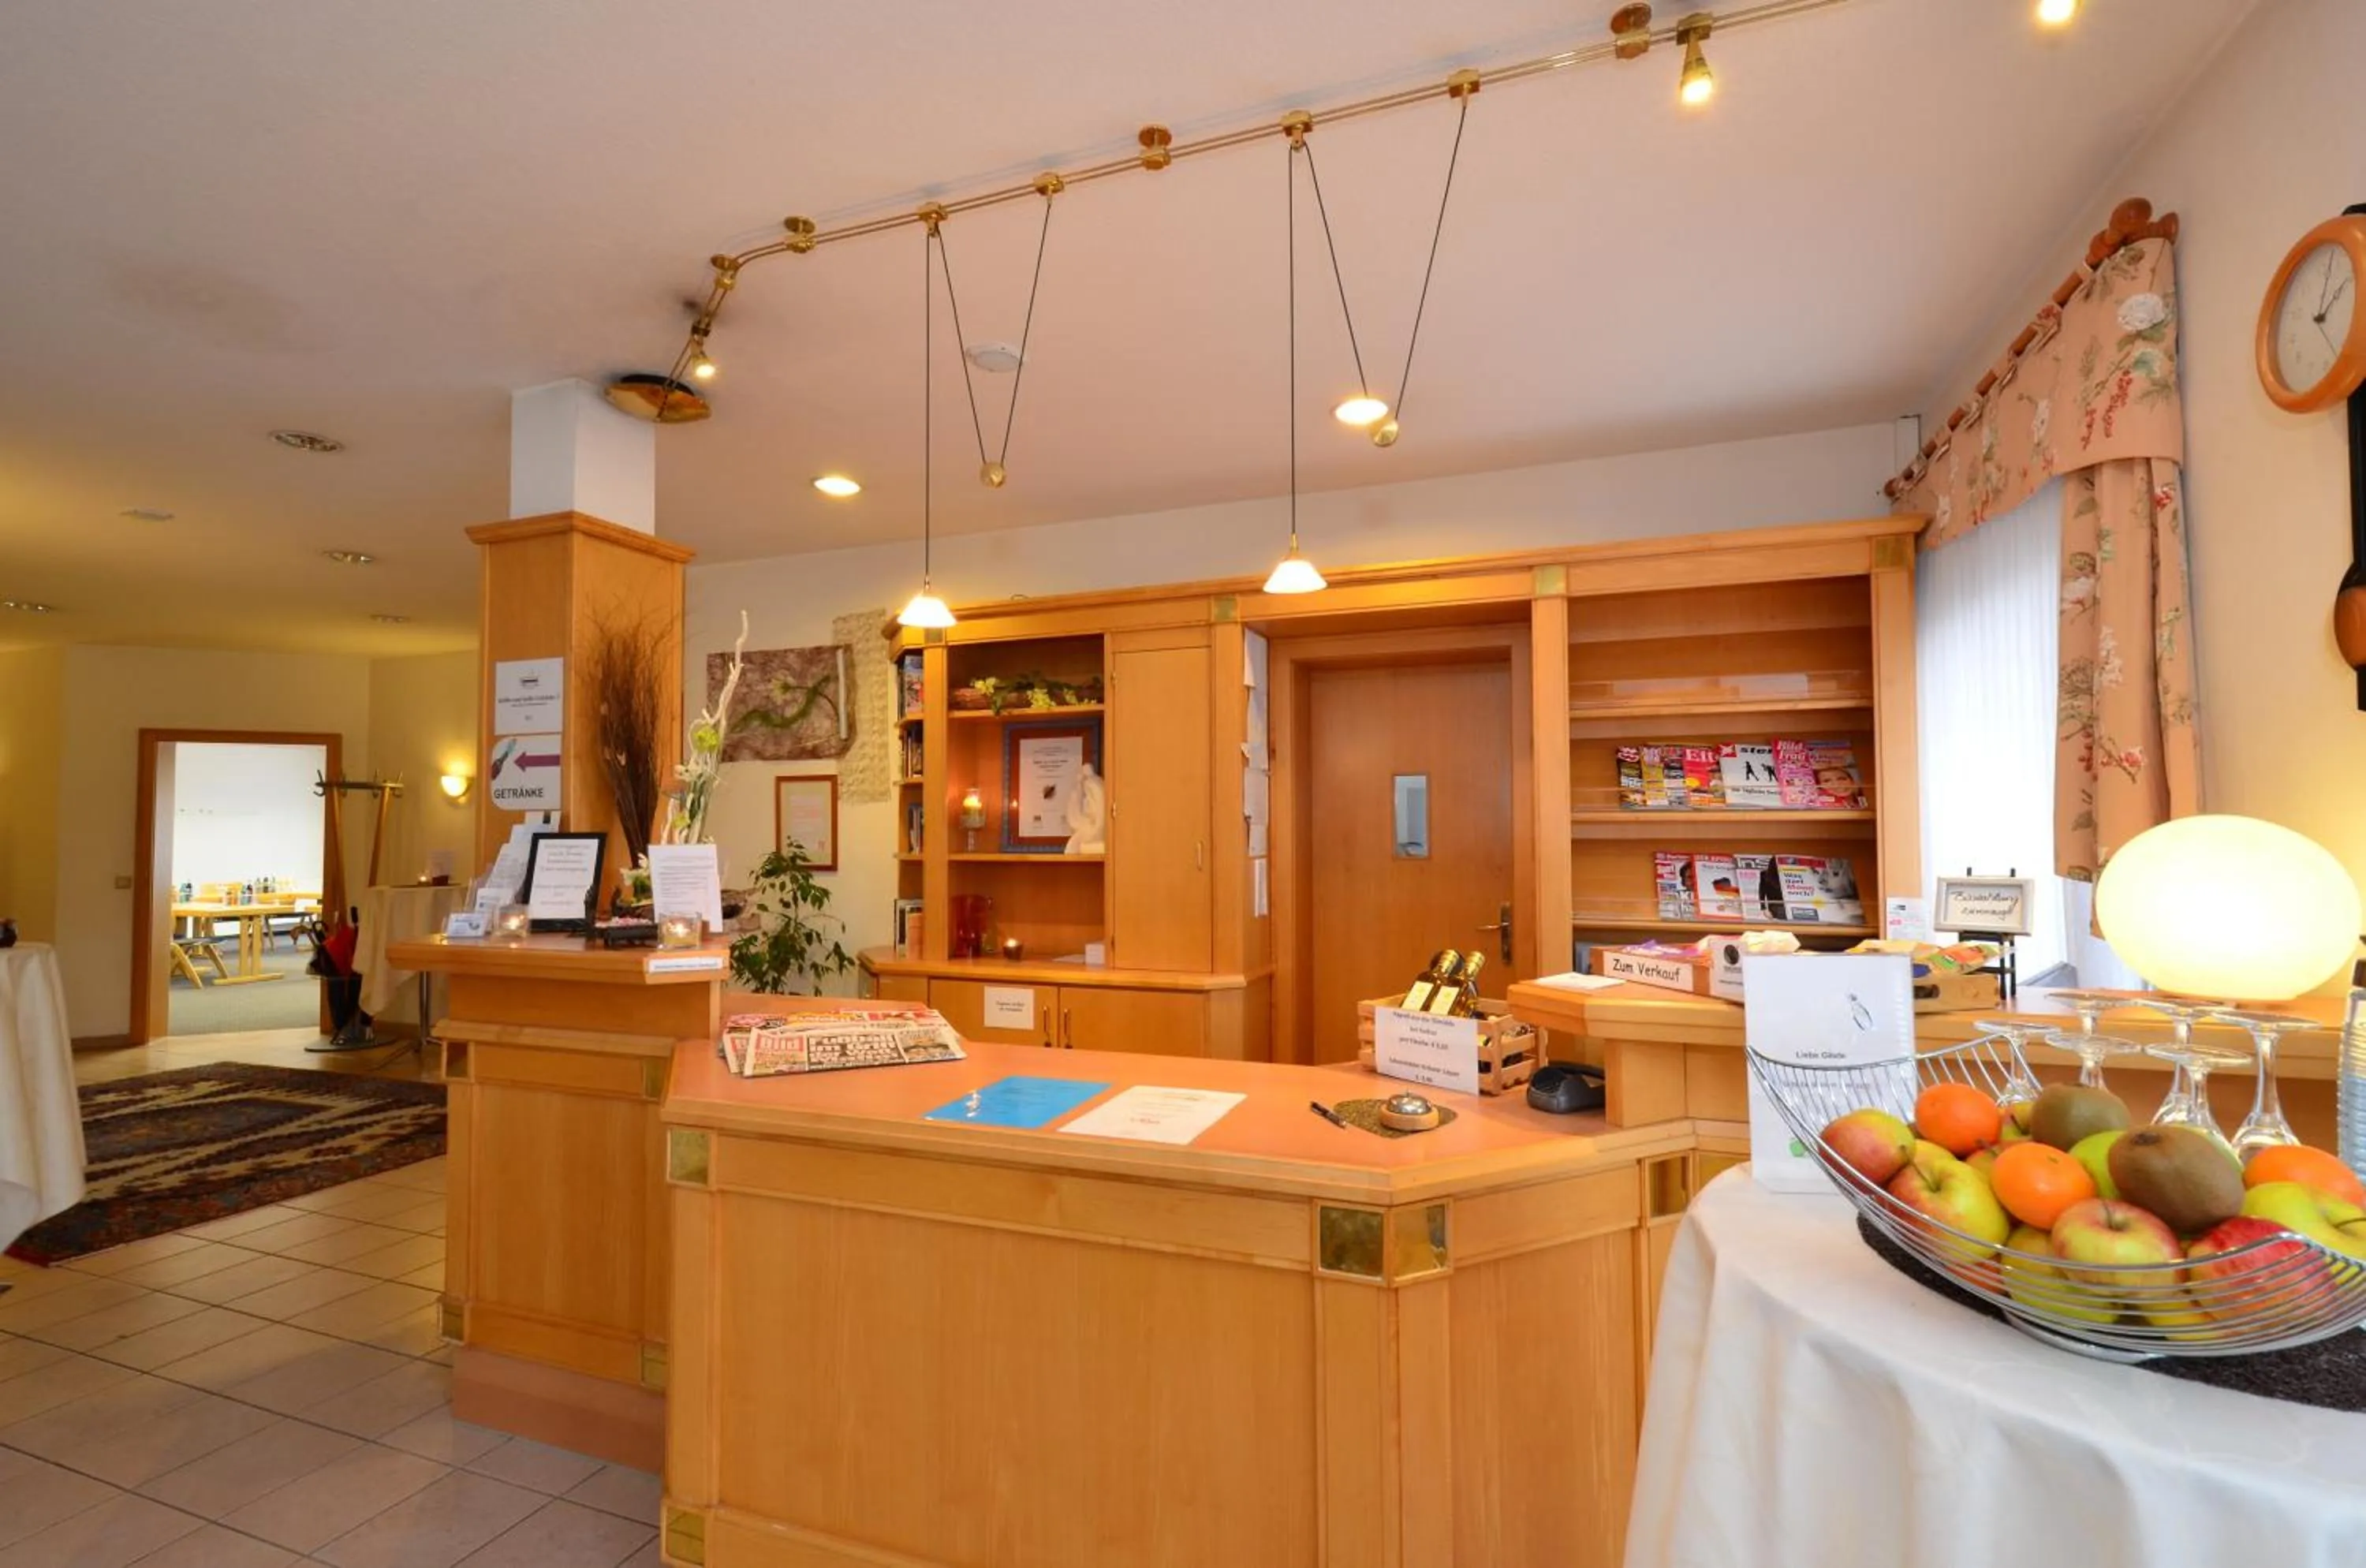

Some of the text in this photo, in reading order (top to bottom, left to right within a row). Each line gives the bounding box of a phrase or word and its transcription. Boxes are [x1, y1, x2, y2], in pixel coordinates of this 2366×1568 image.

[493, 786, 544, 799] GETRÄNKE
[1613, 958, 1681, 983] Zum Verkauf
